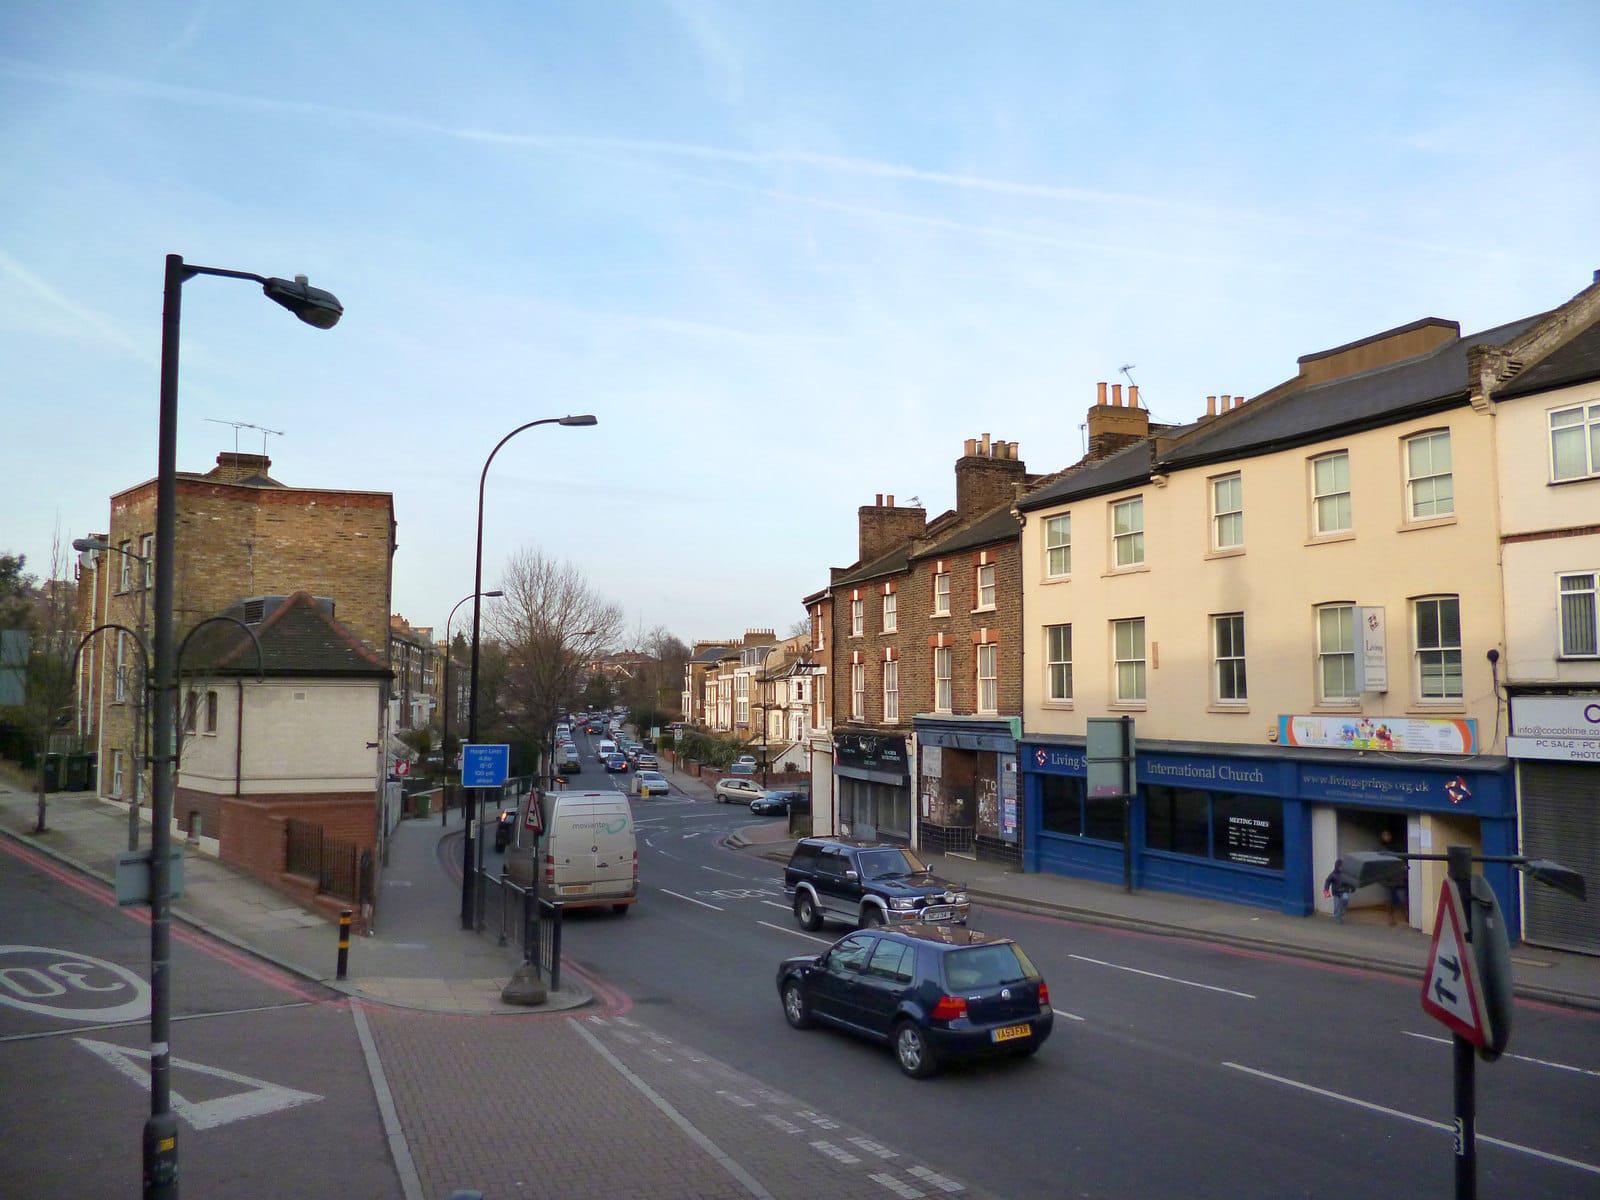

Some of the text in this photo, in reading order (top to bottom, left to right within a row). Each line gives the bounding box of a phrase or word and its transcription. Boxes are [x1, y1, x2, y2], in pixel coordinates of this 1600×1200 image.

[1551, 740, 1575, 749] SALE
[1582, 741, 1596, 749] PC
[1051, 753, 1080, 769] Living
[1147, 760, 1264, 783] International Church
[1303, 775, 1430, 793] www.livingsprings.org.uk
[1229, 817, 1269, 828] MEETING TIMES
